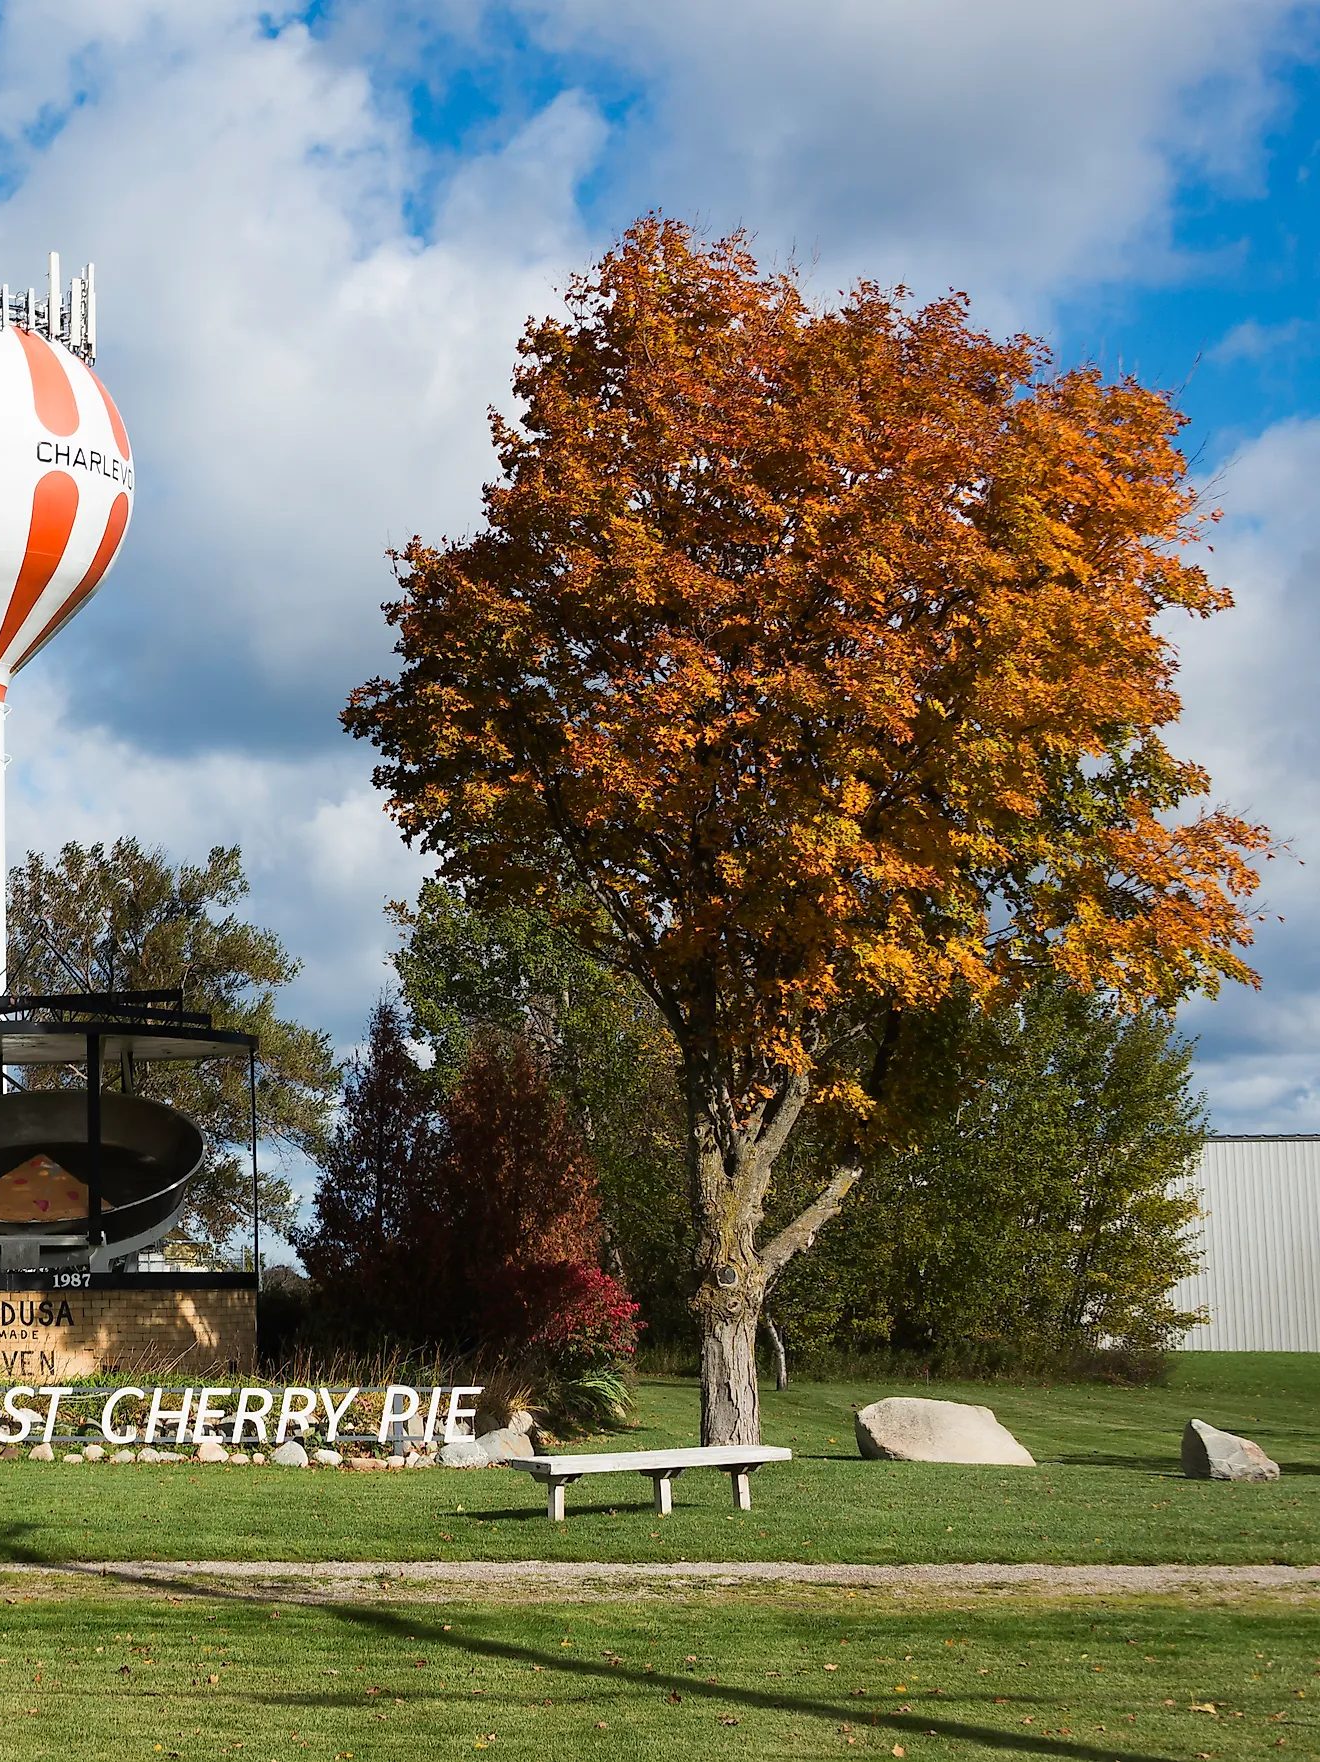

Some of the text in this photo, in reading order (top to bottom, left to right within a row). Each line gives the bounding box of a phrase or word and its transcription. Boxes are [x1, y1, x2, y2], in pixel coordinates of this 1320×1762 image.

[36, 441, 133, 491] CHARLEVO
[53, 1273, 91, 1288] 1987
[101, 1386, 361, 1444] CHERRY
[377, 1386, 485, 1444] PIE
